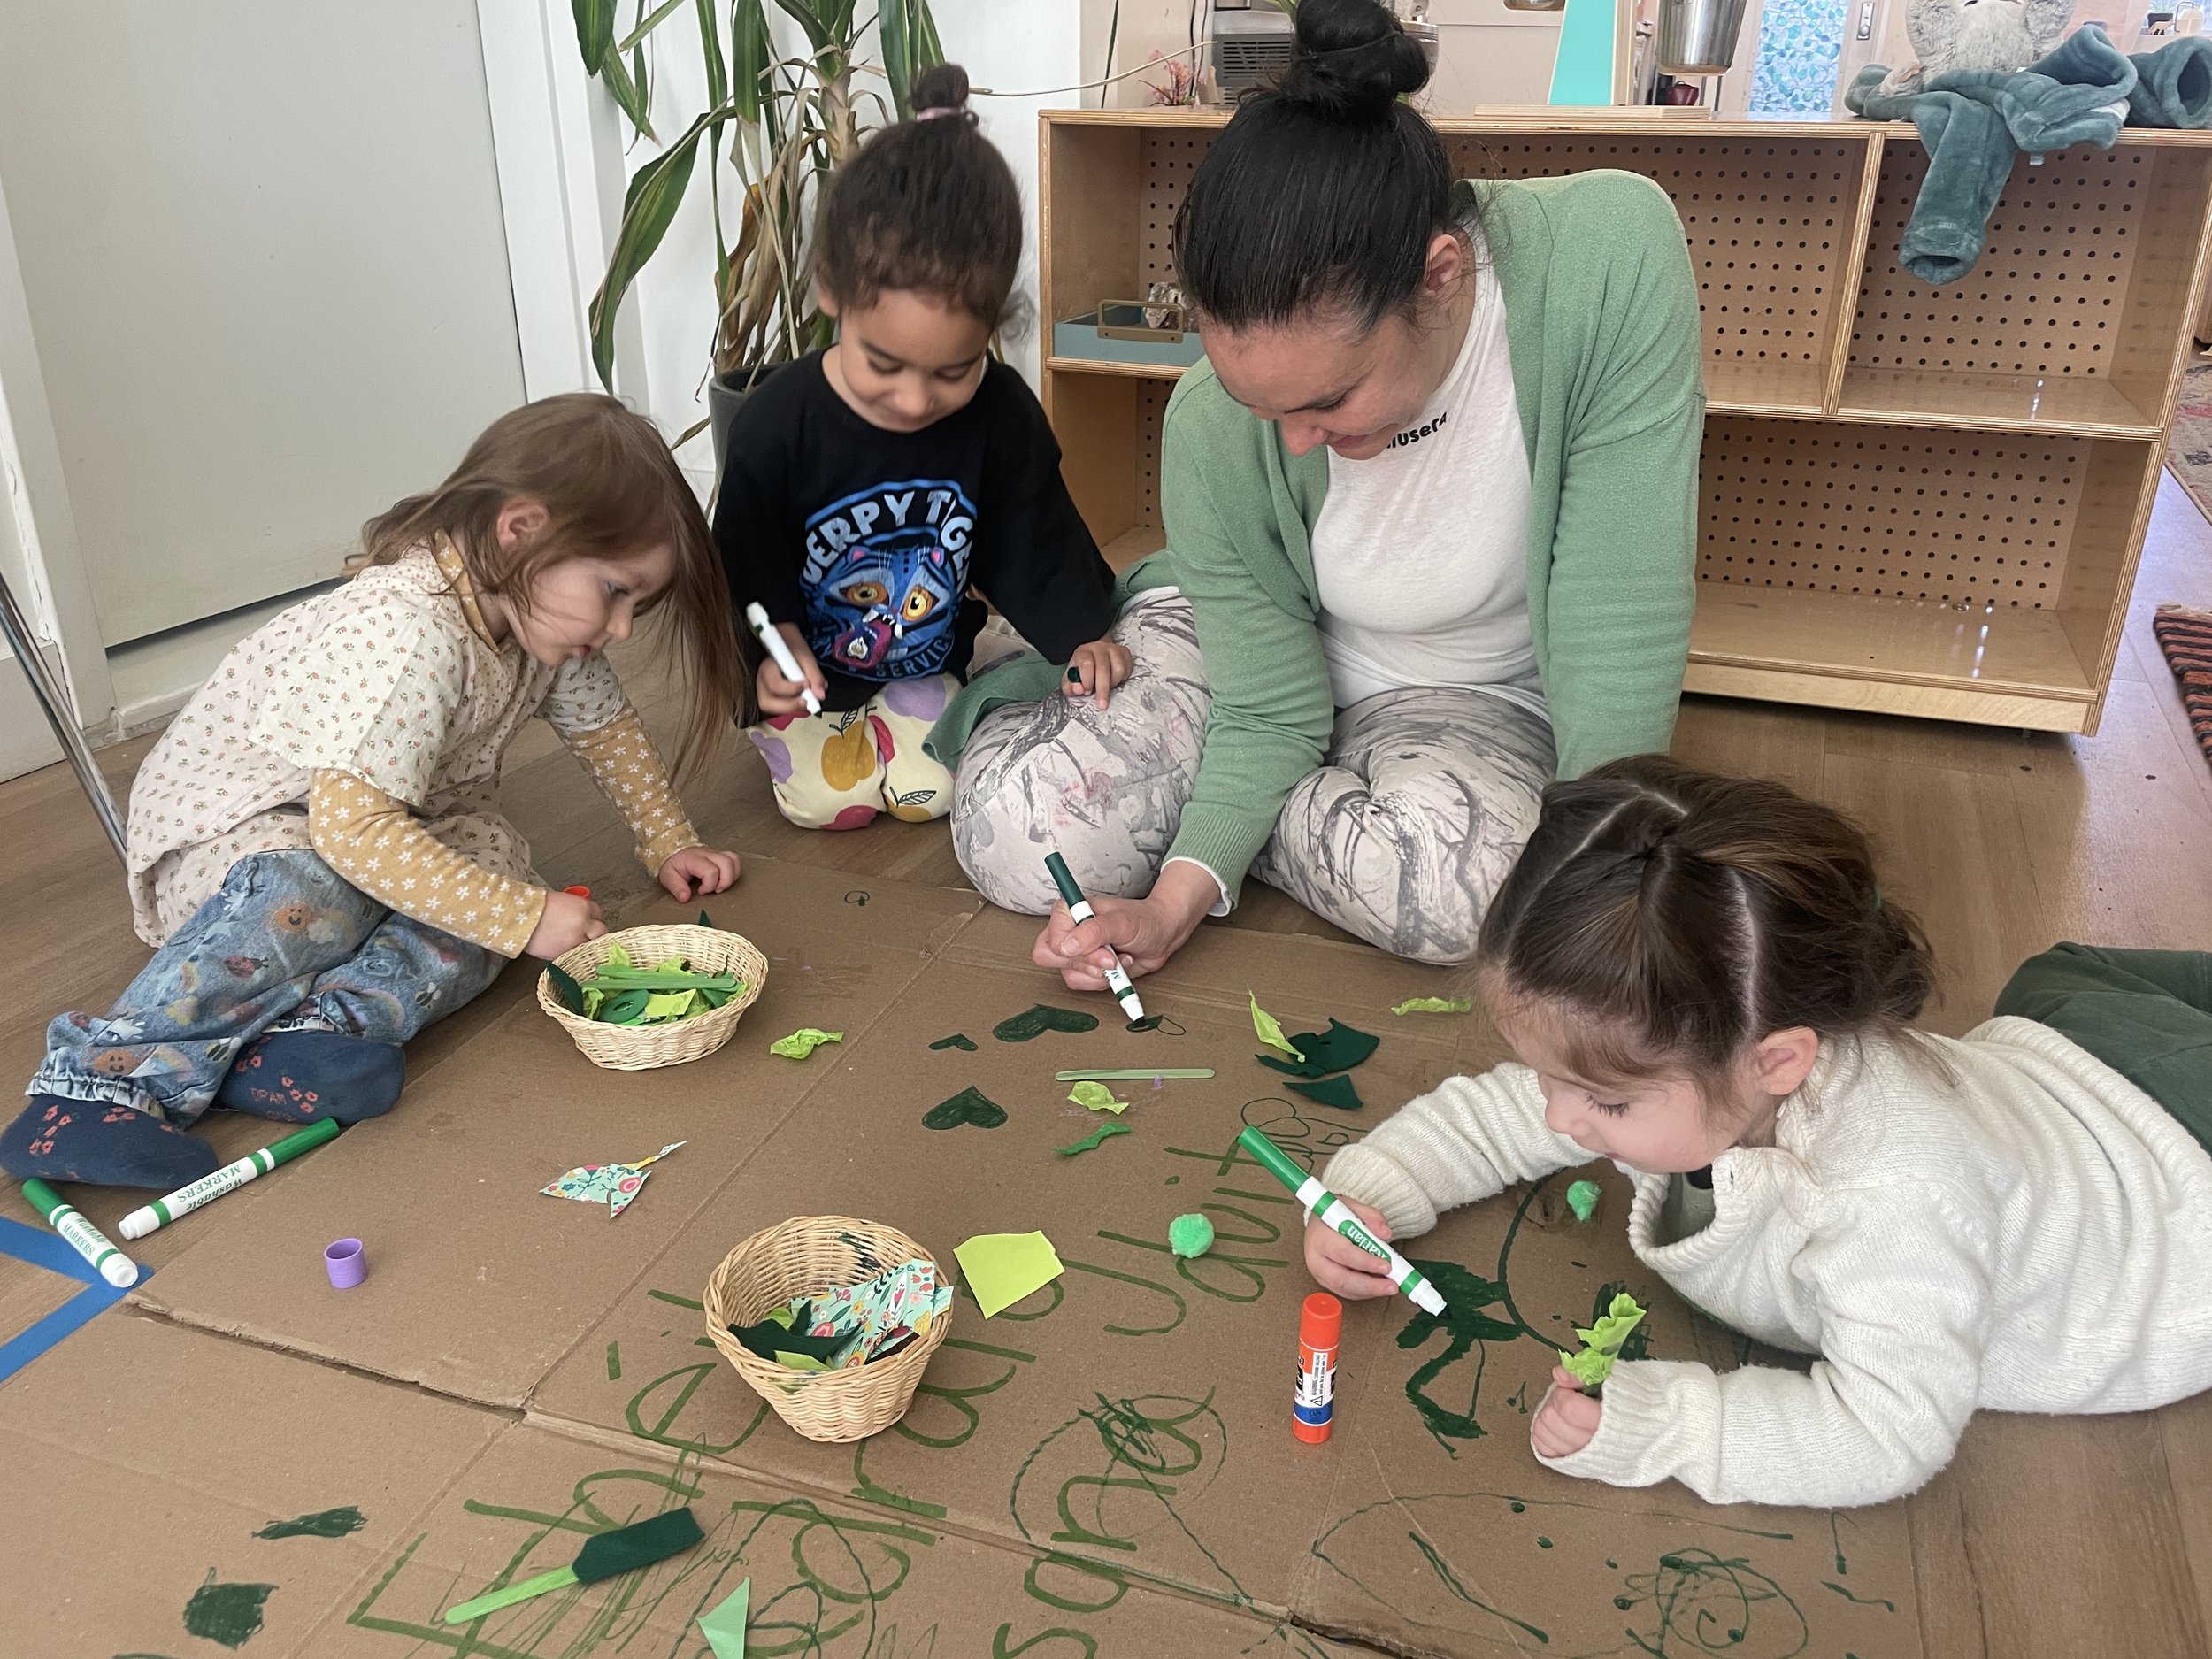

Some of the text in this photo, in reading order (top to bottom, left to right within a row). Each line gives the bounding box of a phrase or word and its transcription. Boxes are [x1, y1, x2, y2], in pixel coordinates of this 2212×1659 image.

[876, 629, 954, 677] SERVIC
[176, 1164, 242, 1203] MARKERS
[184, 1177, 242, 1211] Washable
[62, 1223, 96, 1257] MARKERS
